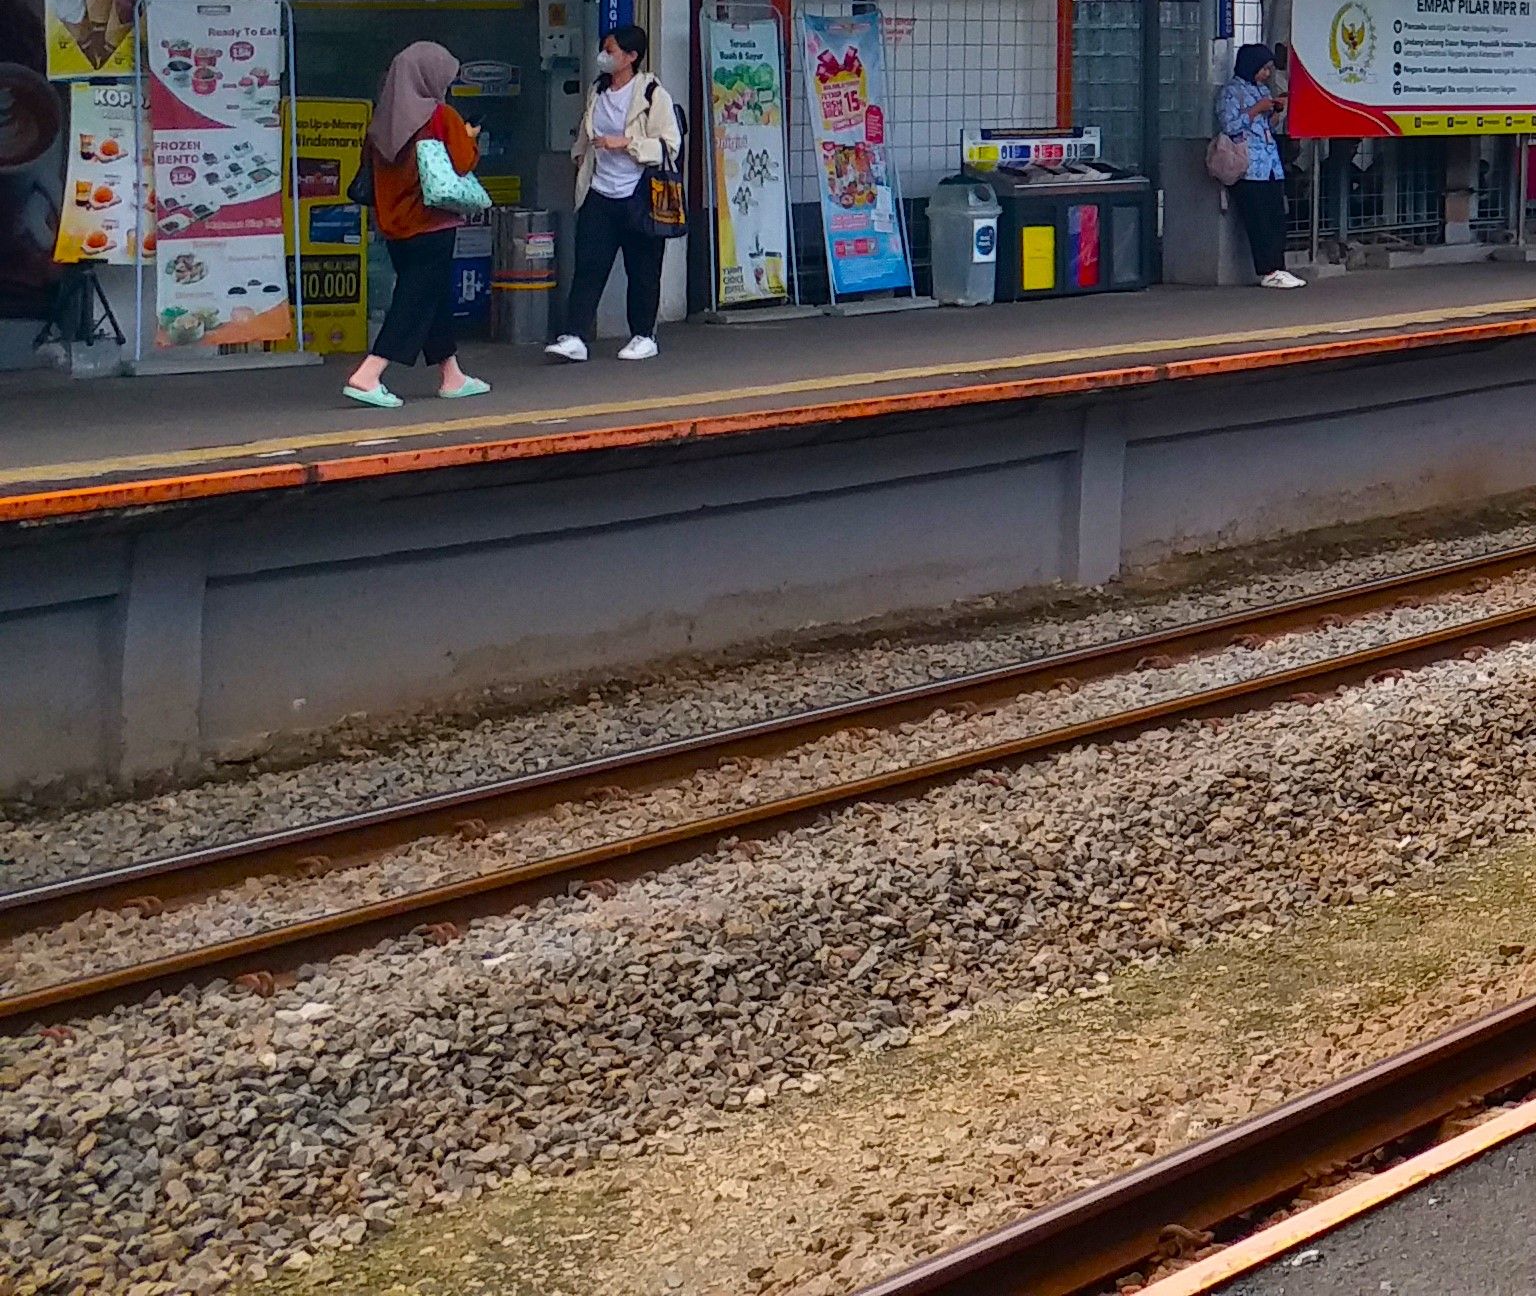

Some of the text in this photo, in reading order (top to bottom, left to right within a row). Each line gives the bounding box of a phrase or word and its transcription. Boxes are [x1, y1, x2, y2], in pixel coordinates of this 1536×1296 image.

[1458, 0, 1490, 15] PILAR
[1493, 0, 1517, 16] MPR
[1519, 2, 1530, 16] RI
[208, 27, 278, 38] Ready To Eat
[155, 141, 201, 150] FROZEN
[157, 154, 199, 164] BENTO
